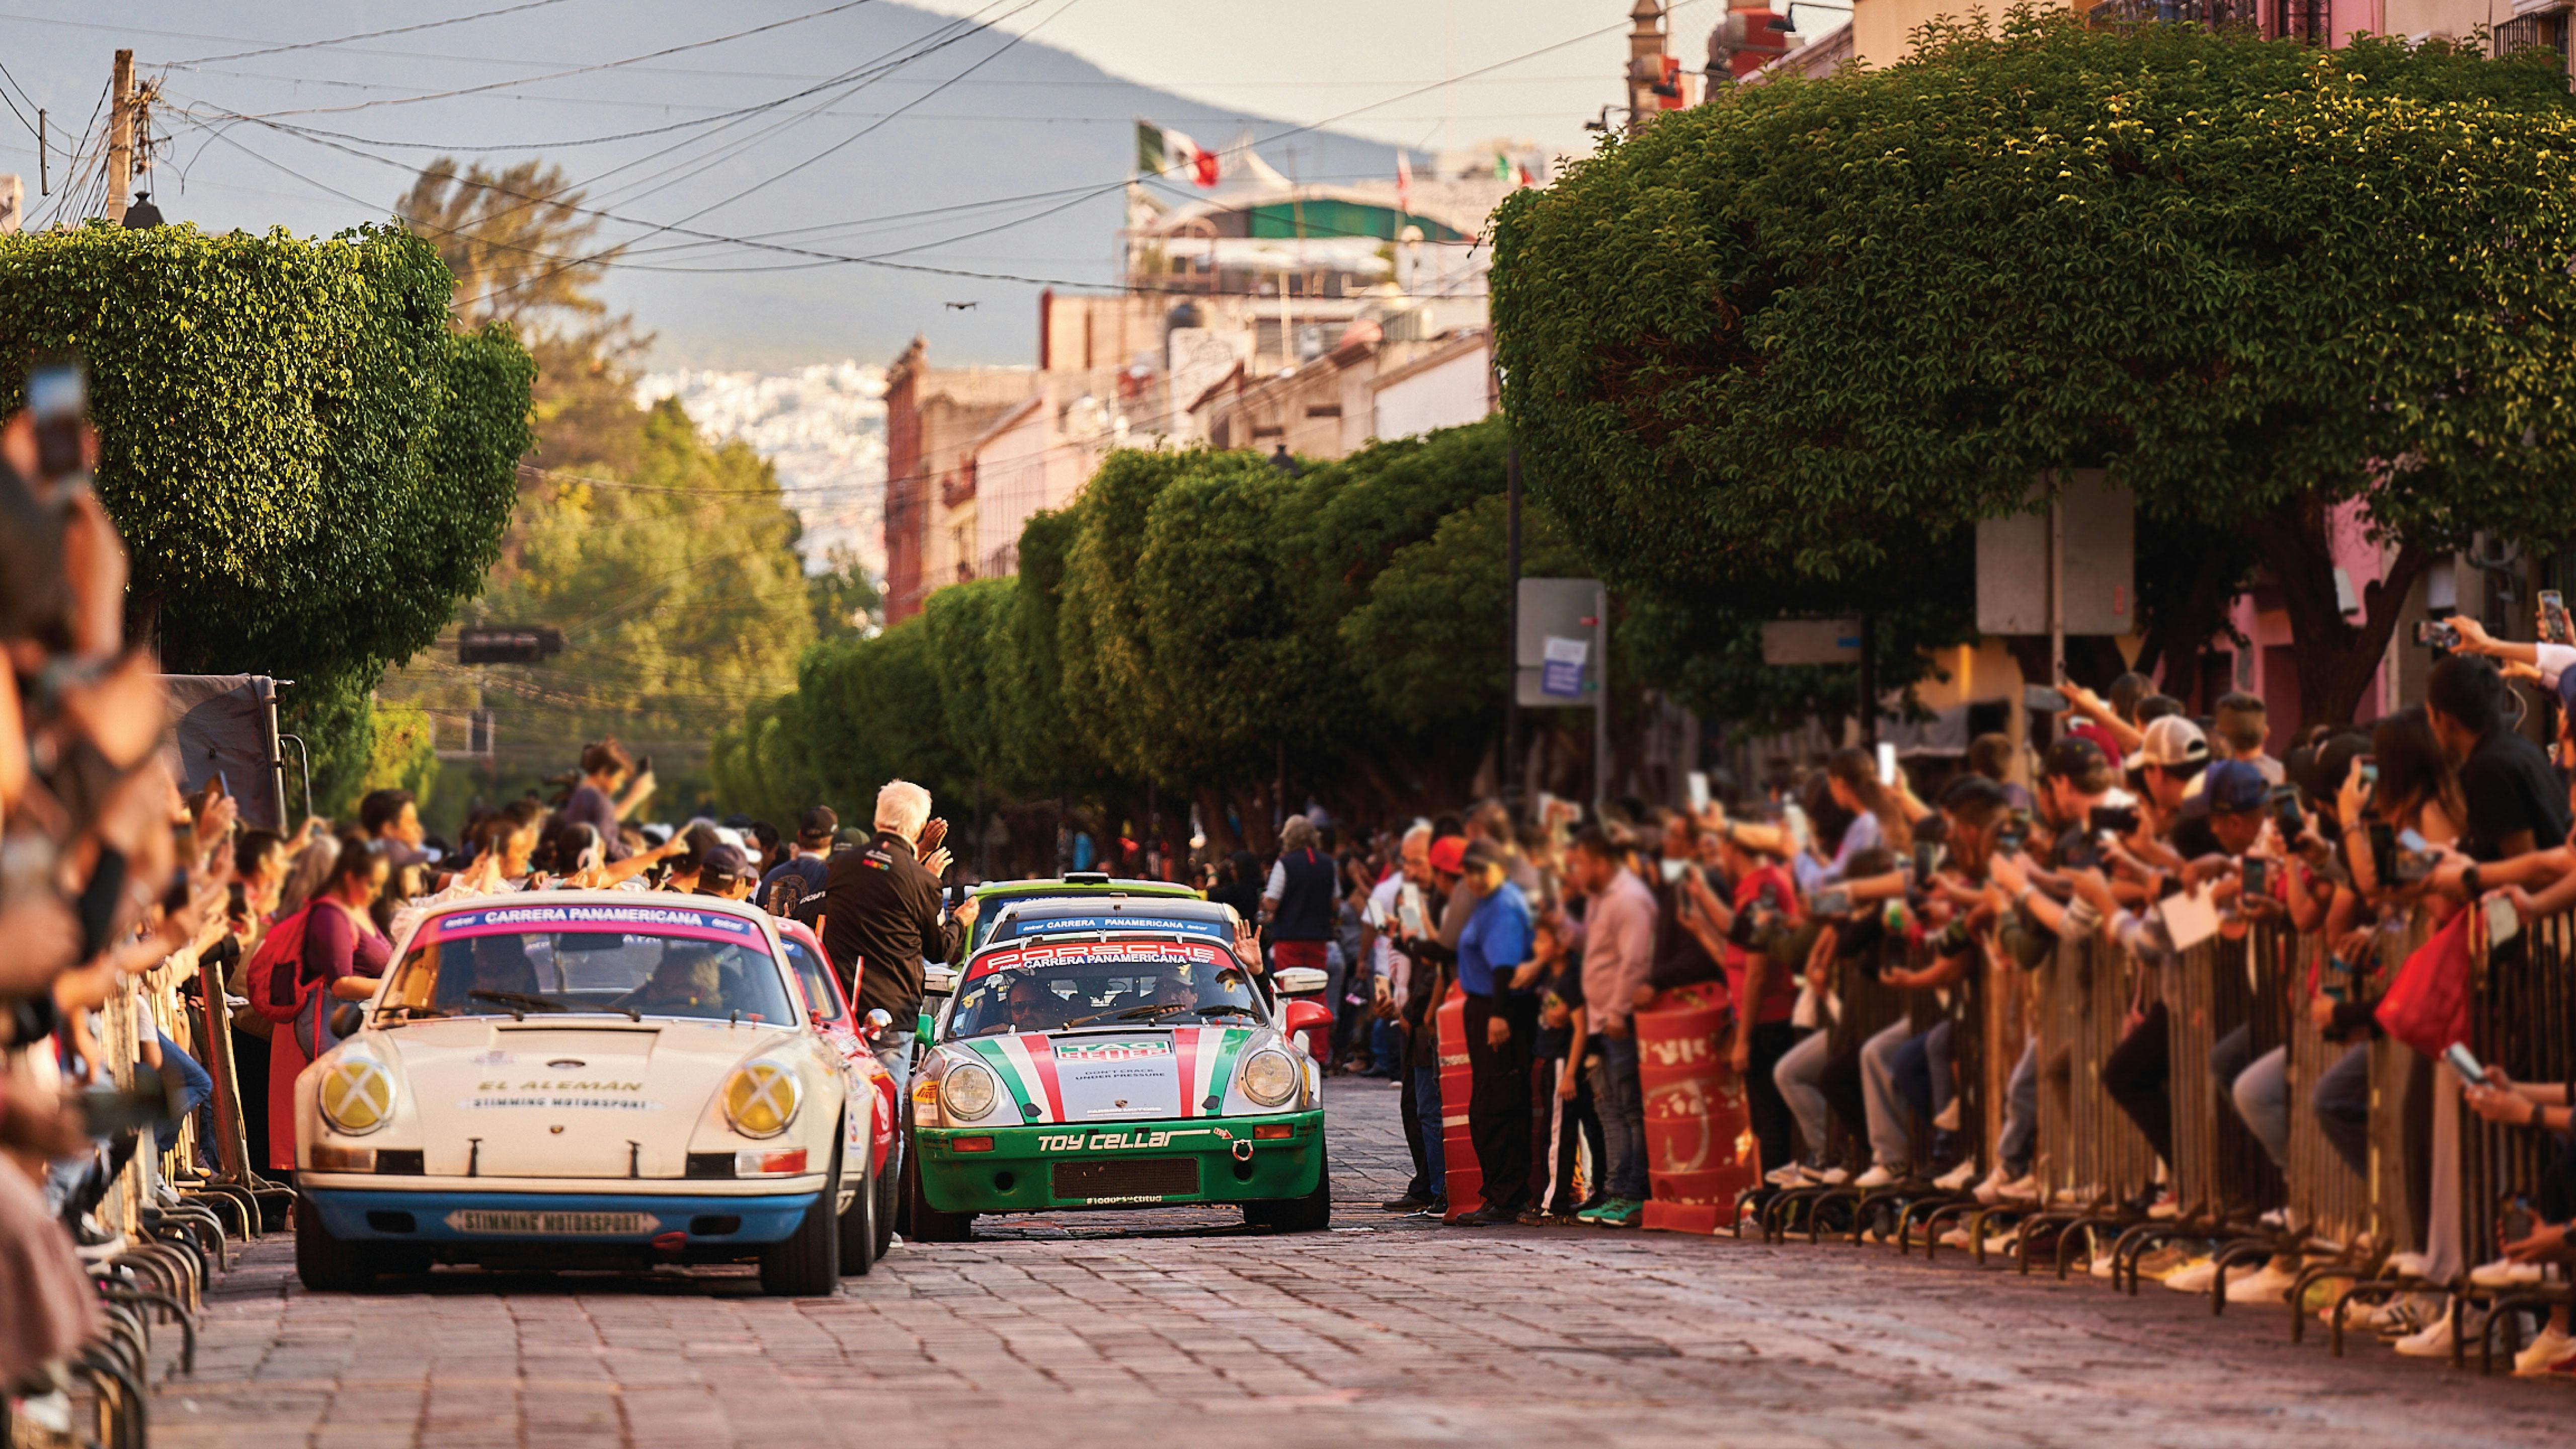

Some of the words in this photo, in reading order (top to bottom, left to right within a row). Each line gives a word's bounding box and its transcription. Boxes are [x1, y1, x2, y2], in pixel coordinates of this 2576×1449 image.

[485, 909, 567, 924] CARRERA
[569, 908, 702, 926] PANAMERICANA
[1046, 919, 1095, 929] CARRERA
[1104, 919, 1183, 929] PANAMERICANA
[987, 944, 1215, 969] PORSCHE
[1024, 955, 1085, 969] CARRERA
[1087, 953, 1187, 964] PANAMERICANA
[1065, 1043, 1157, 1053] TAG
[477, 1081, 508, 1090] EL
[552, 1098, 647, 1108] MOTORSPORT
[1038, 1134, 1085, 1151] TOY
[465, 1212, 538, 1230] STIMMING
[543, 1213, 639, 1232] MOTORSPORT
